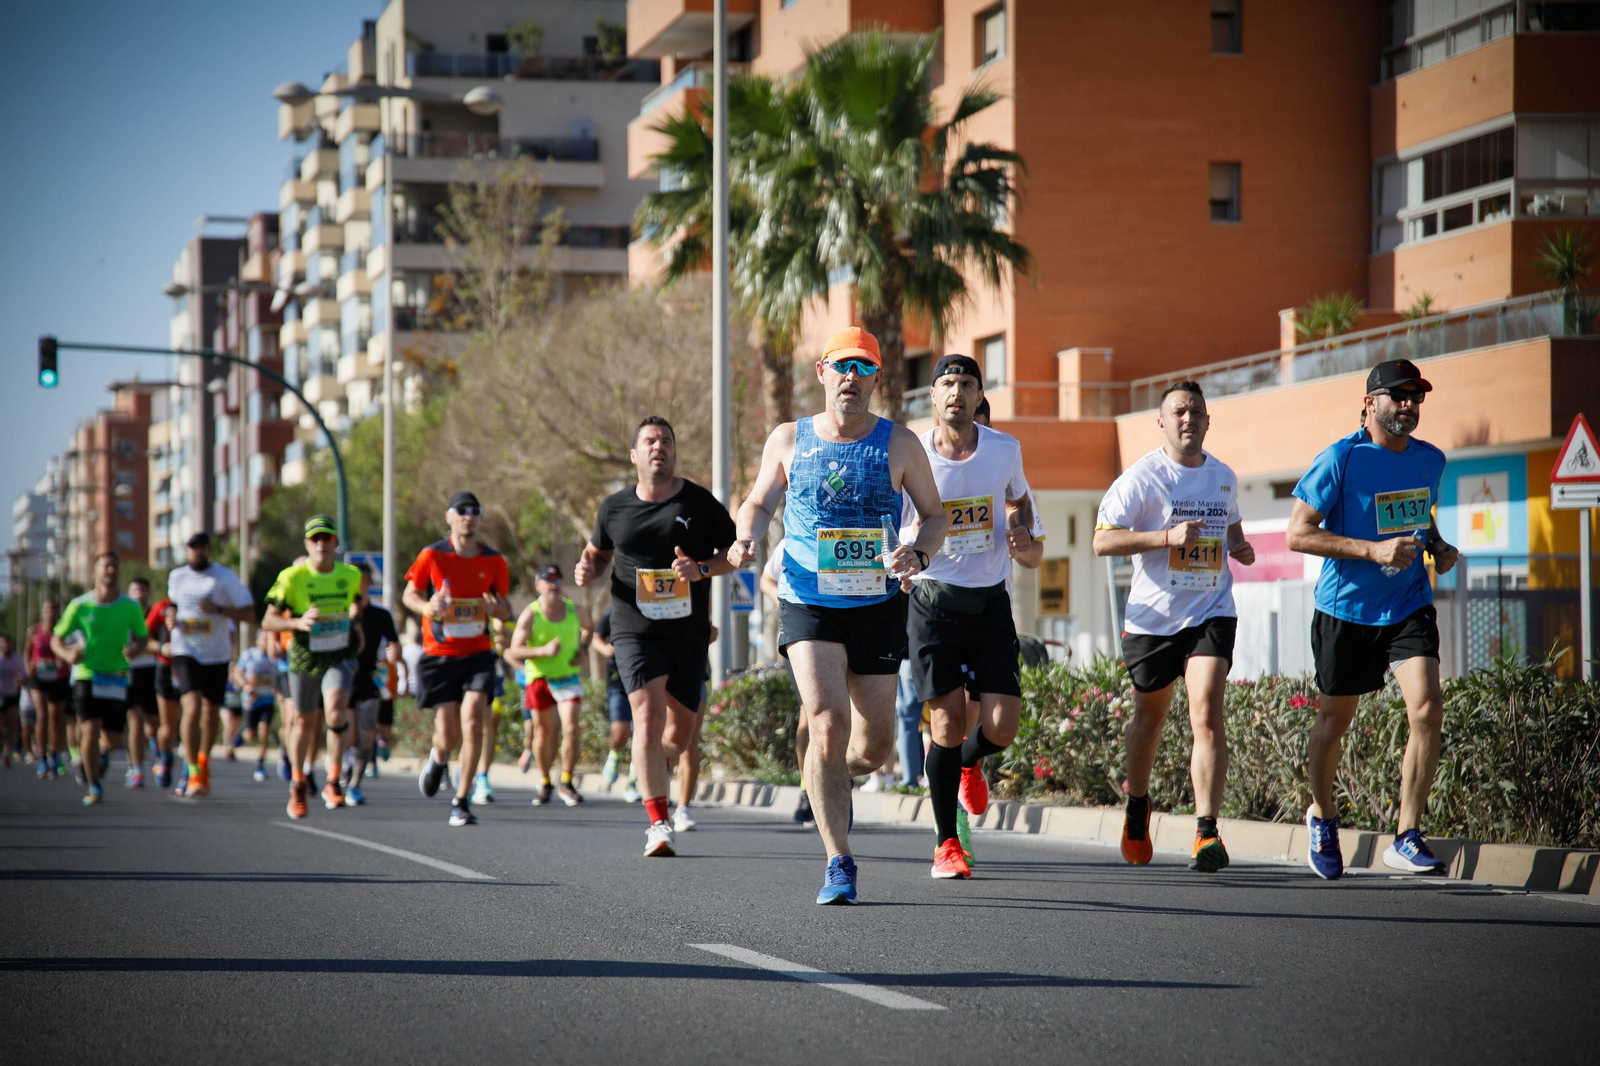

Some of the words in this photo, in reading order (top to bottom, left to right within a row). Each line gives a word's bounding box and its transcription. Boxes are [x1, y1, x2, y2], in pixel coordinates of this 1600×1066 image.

[951, 506, 989, 525] 212
[1172, 508, 1205, 516] Almería
[1206, 508, 1228, 516] 2024
[1385, 499, 1426, 520] 1137
[834, 540, 876, 560] 695
[1178, 546, 1217, 562] 1411
[654, 578, 676, 593] 37
